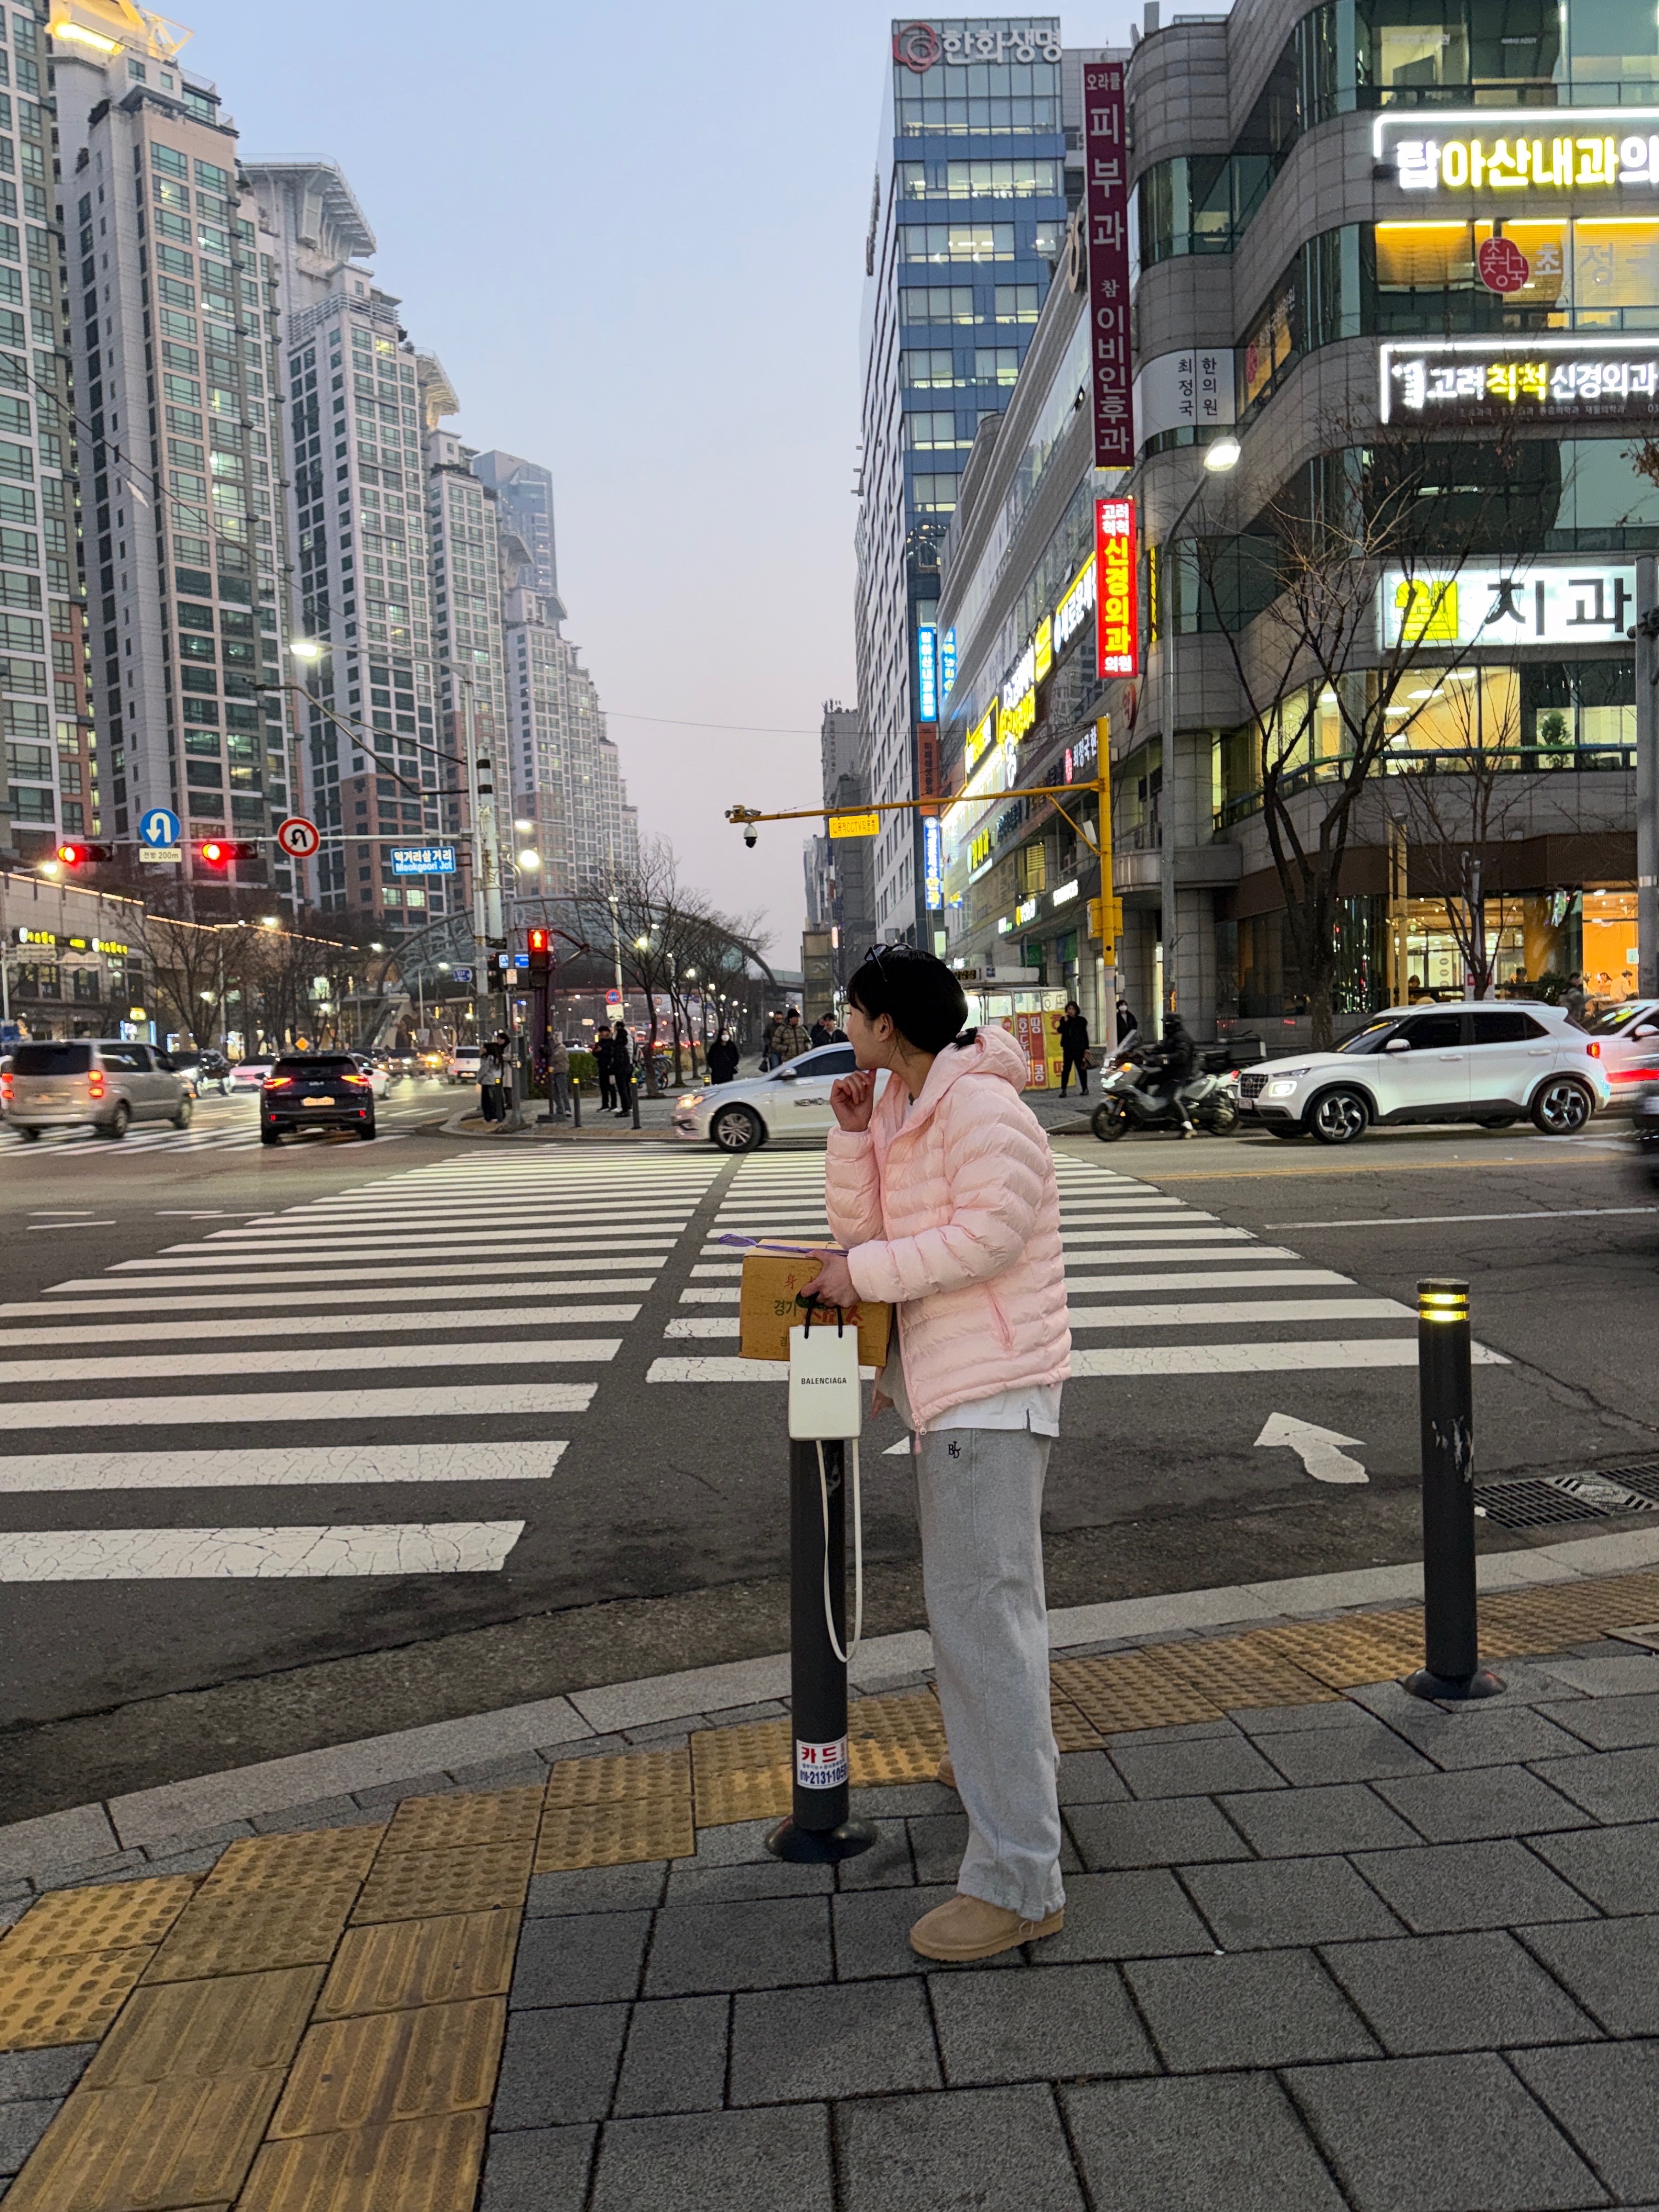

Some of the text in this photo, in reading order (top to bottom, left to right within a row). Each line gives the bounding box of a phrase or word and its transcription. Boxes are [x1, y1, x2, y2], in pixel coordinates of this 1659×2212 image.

[942, 28, 1062, 64] 한화생명
[1086, 72, 1121, 91] 오라클
[1090, 104, 1125, 251] 피부과
[1100, 279, 1120, 298] 참
[1097, 305, 1130, 454] 이비인후과
[1178, 358, 1193, 417] 최정국
[1201, 357, 1217, 416] 한의원
[1102, 503, 1130, 520] 고려
[1104, 537, 1131, 654] 신경외과
[1104, 656, 1132, 673] 의원
[394, 849, 452, 863] 먹거리삼거리
[439, 861, 453, 871] Jct
[1031, 1017, 1045, 1082] 땅콩
[774, 1300, 797, 1316] 경기
[801, 1746, 837, 1764] 카드
